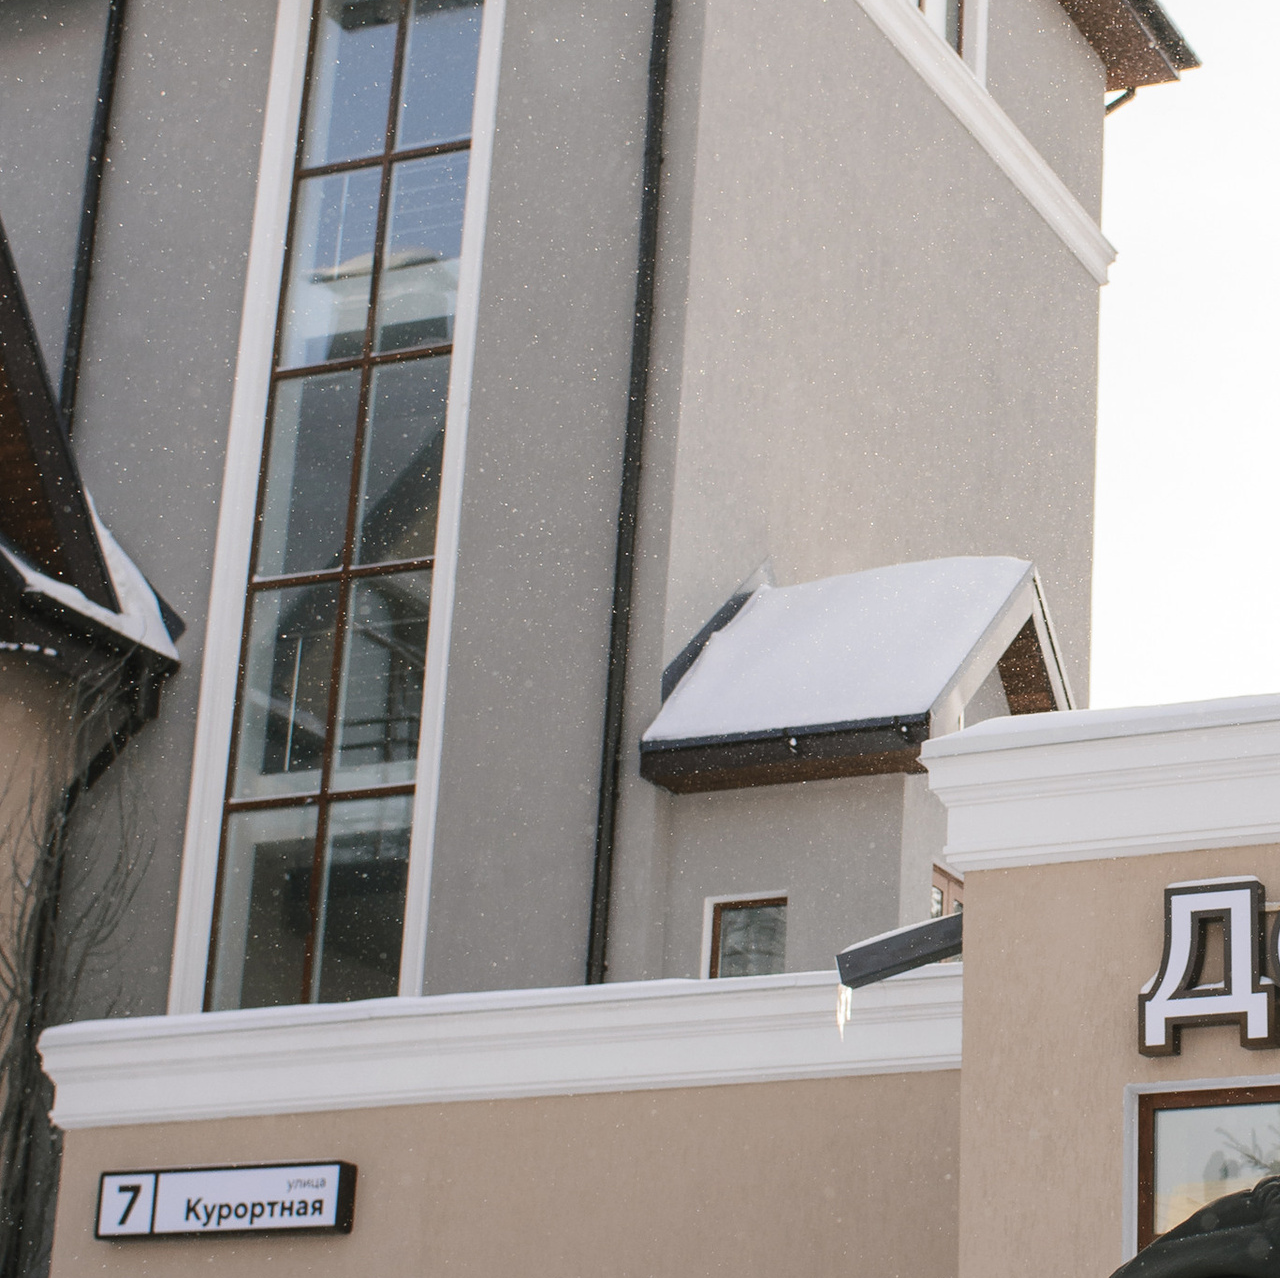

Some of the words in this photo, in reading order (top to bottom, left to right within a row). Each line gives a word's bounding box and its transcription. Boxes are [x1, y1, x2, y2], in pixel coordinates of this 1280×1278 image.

[287, 1177, 326, 1192] улица
[117, 1184, 142, 1225] 7
[185, 1197, 324, 1226] Курортная
